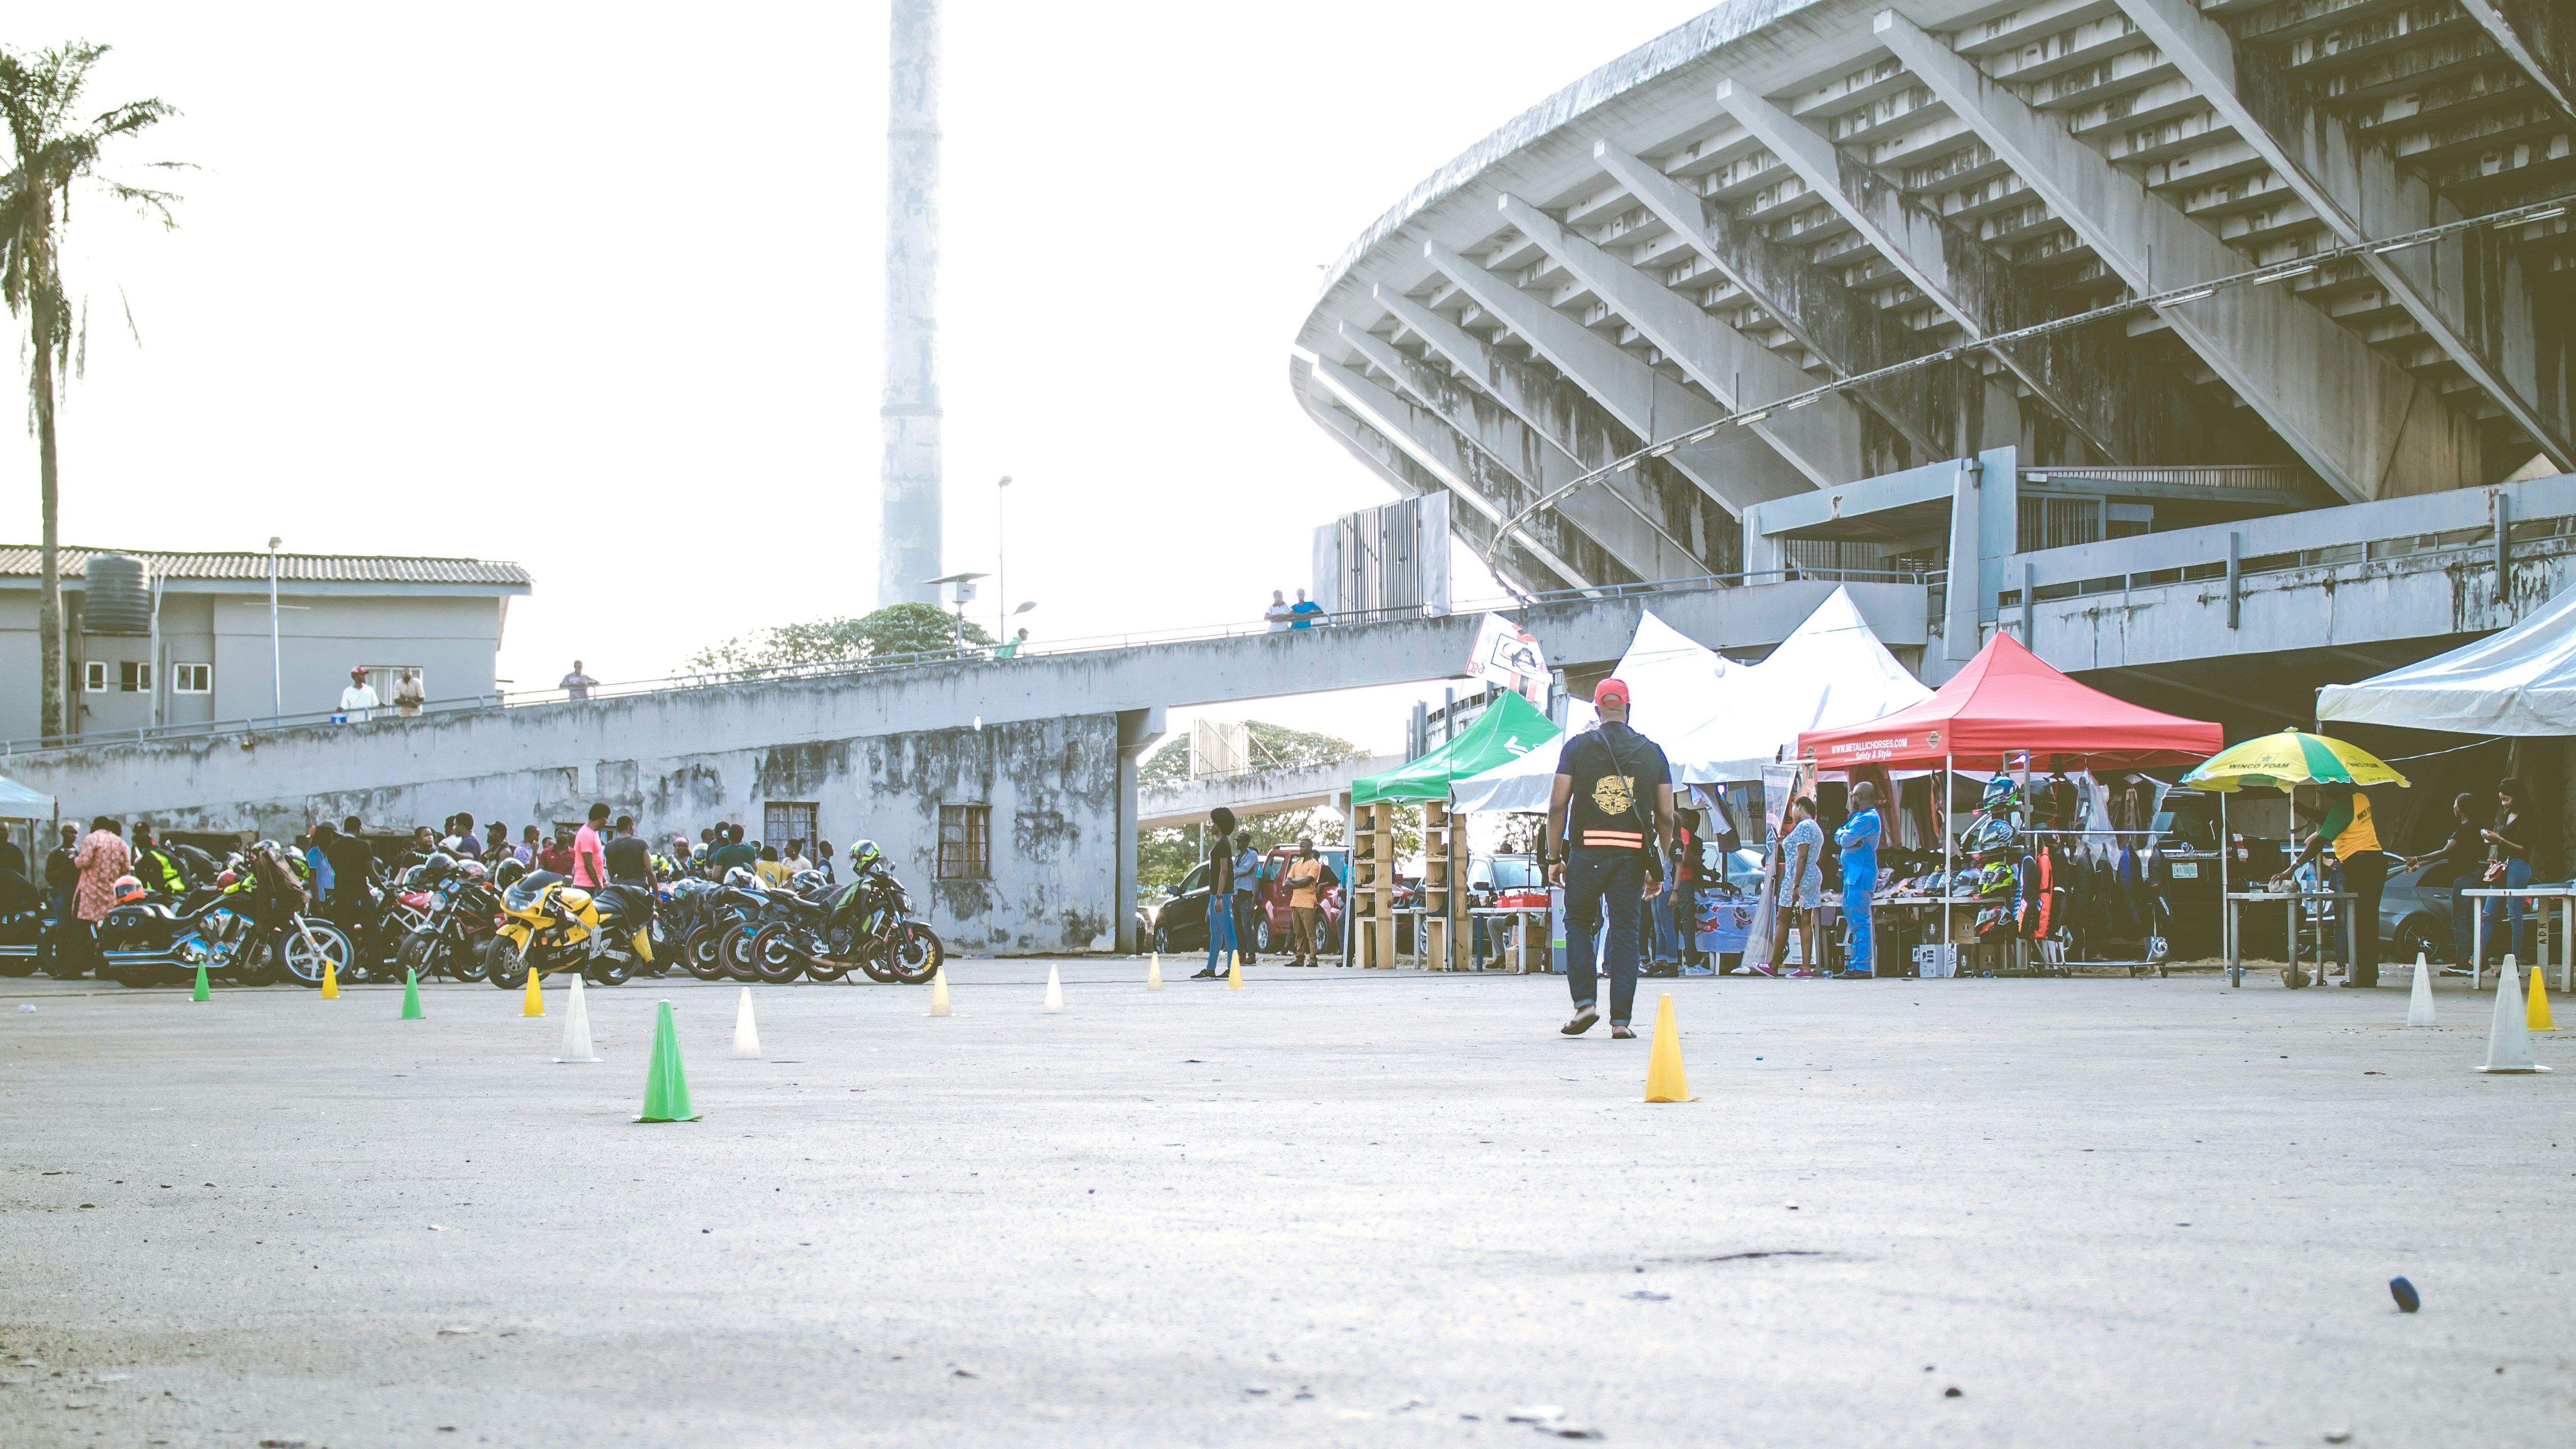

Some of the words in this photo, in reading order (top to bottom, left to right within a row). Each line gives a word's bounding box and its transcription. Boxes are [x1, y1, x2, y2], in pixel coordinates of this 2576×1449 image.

[1831, 738, 1907, 754] WWW.METALLICHORSES.COM
[1855, 751, 1871, 761] Safety
[1872, 749, 1876, 759] &
[1878, 749, 1892, 760] Style
